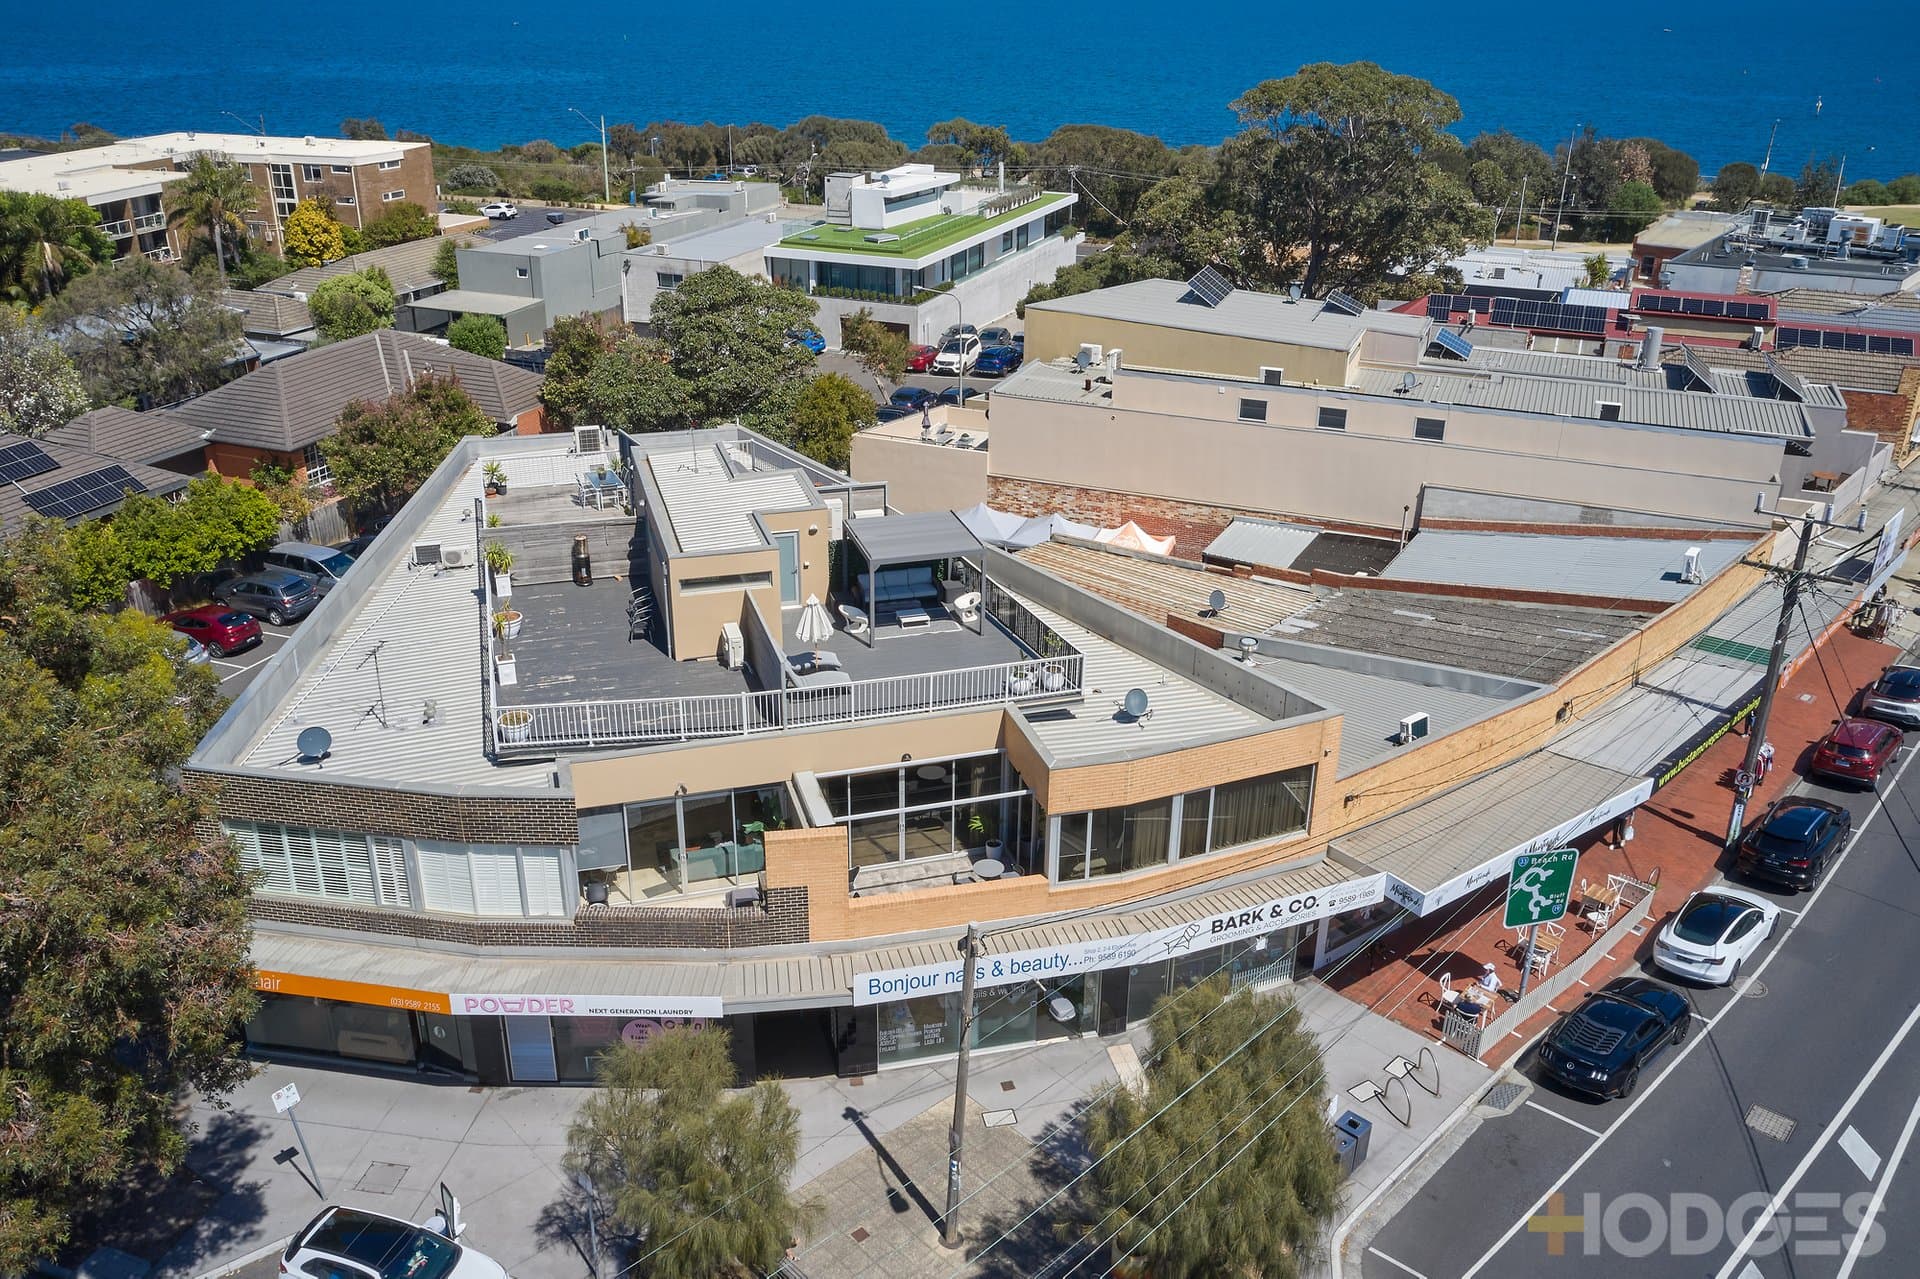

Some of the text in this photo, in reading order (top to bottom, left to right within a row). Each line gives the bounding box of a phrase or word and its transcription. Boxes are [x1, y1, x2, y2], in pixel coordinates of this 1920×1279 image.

[1531, 854, 1558, 865] Beach
[1209, 928, 1255, 944] GROOMING
[1263, 911, 1317, 930] ACCESSORIES
[1211, 907, 1264, 934] BARK
[1269, 904, 1283, 918] &
[1288, 895, 1320, 914] CO.
[868, 952, 1083, 996] Bonjour nas & beauty...
[464, 996, 575, 1014] POWDER
